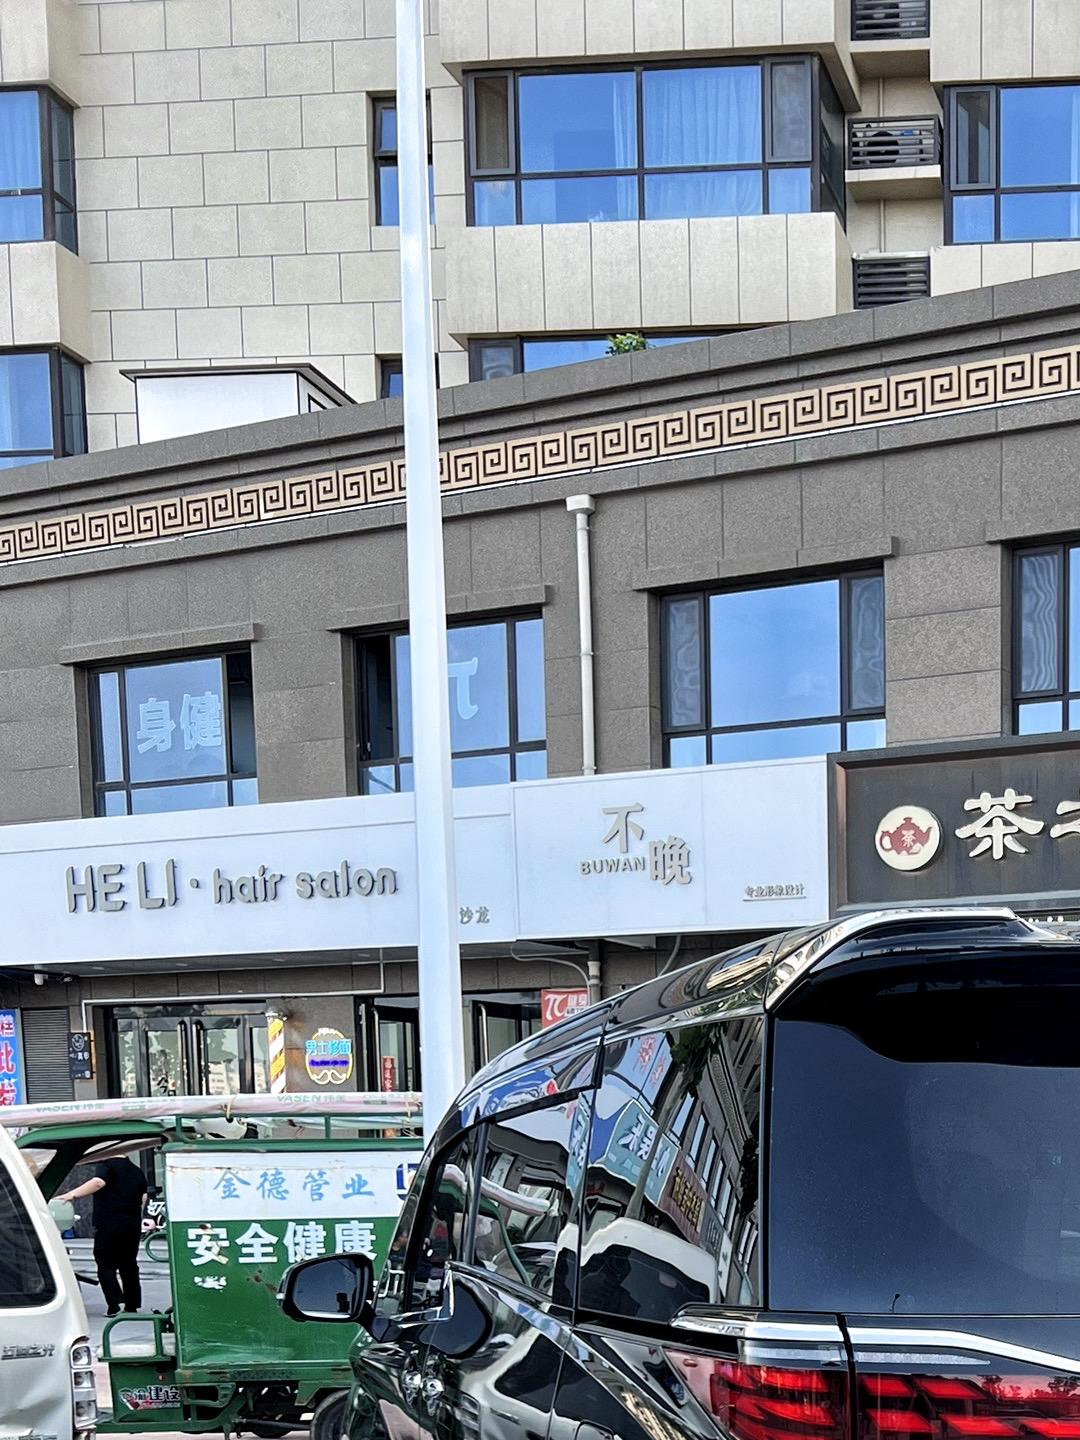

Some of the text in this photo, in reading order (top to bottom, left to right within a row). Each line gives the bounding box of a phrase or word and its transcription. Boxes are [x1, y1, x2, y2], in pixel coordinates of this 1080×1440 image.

[602, 802, 693, 886] 不晚
[66, 863, 127, 914] HE
[136, 857, 179, 910] LI
[212, 864, 285, 905] hair
[295, 859, 398, 899] salon
[580, 857, 646, 875] BUWAN
[458, 906, 490, 925] 沙龙
[213, 1168, 374, 1202] 金德管业
[186, 1219, 378, 1267] 安全健康
